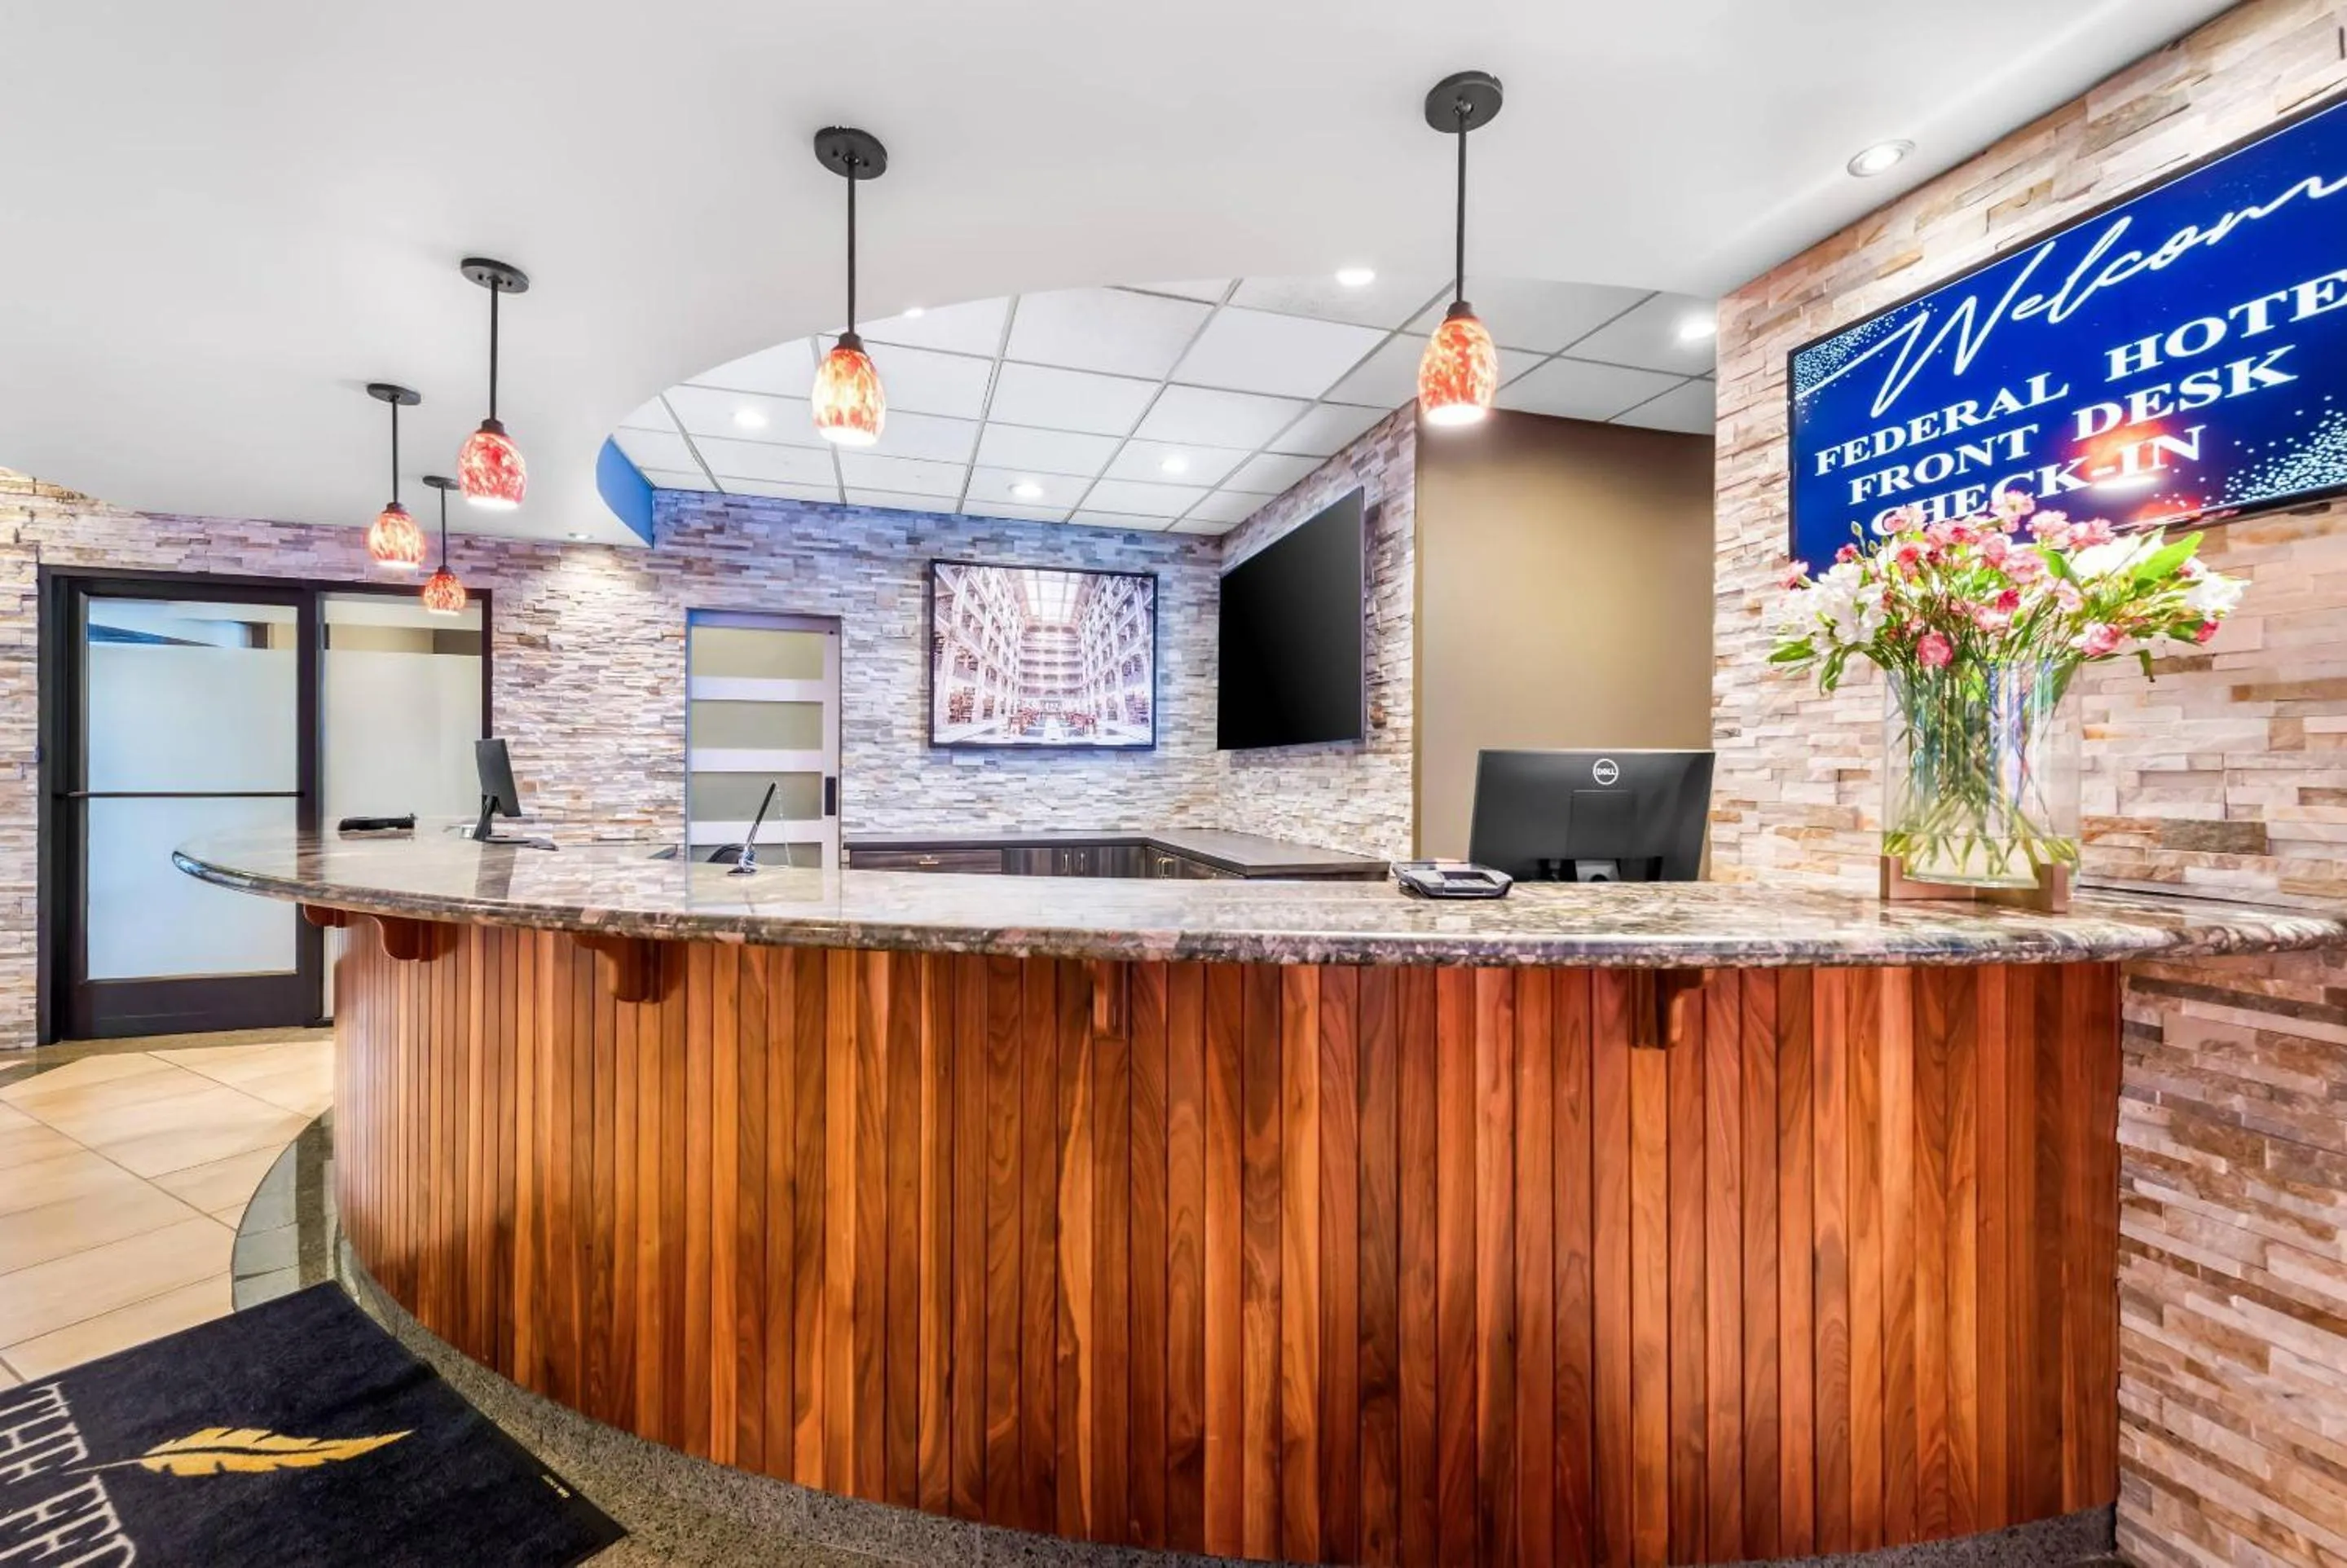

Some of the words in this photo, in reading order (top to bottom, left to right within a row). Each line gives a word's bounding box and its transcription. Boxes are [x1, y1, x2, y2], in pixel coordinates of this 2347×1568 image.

[1814, 372, 2070, 469] FEDERAL
[2103, 268, 2347, 383] HOTE
[1847, 422, 2039, 506] FRONT
[2071, 344, 2300, 443] DESK
[1871, 425, 2208, 537] CHECK-IN
[1596, 767, 1616, 776] DELL
